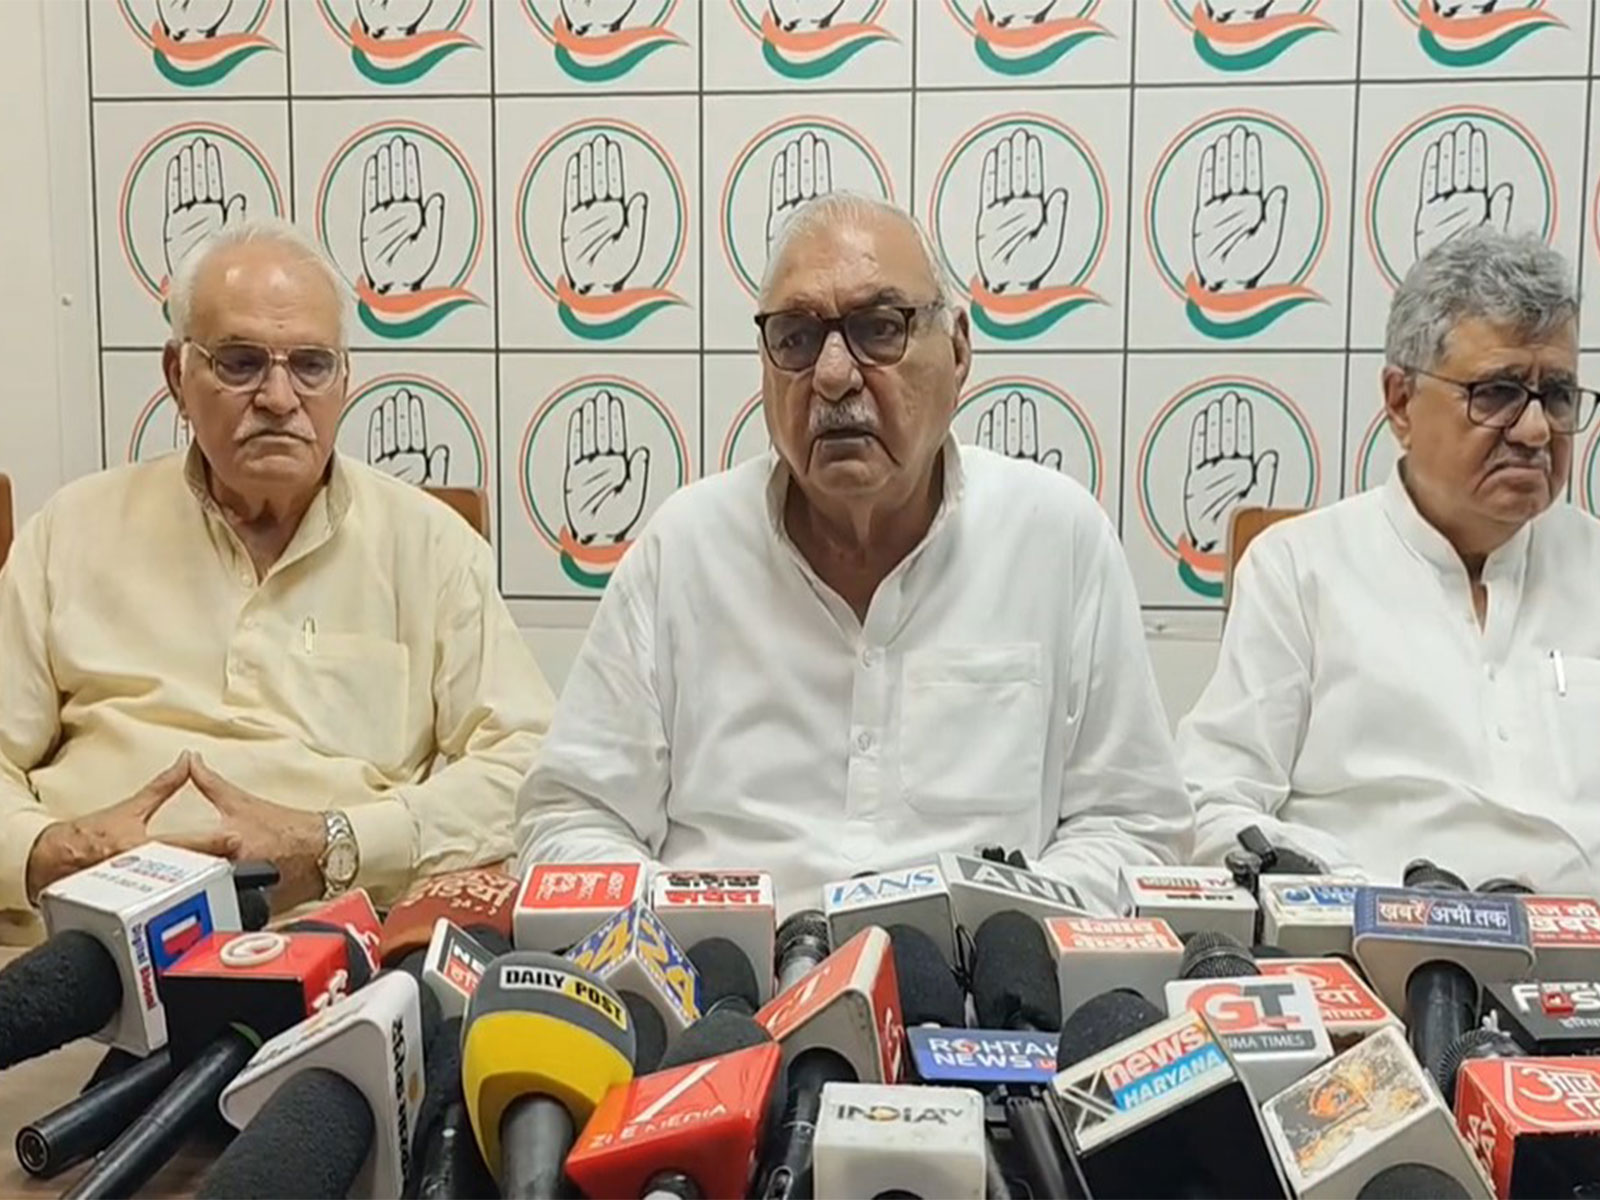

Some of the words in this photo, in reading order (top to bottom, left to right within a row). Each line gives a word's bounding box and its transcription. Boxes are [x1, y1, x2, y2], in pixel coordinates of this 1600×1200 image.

[831, 870, 936, 905] IANS
[970, 863, 1084, 909] ANI
[1431, 902, 1472, 925] अभी
[1473, 908, 1508, 927] तक
[505, 969, 565, 989] DAILY
[574, 981, 622, 1021] POST
[1186, 982, 1296, 1031] GT
[933, 1053, 1032, 1069] NEWS
[1103, 1024, 1206, 1089] news
[1261, 1034, 1305, 1049] TIMES
[1124, 1050, 1223, 1109] HARYANA
